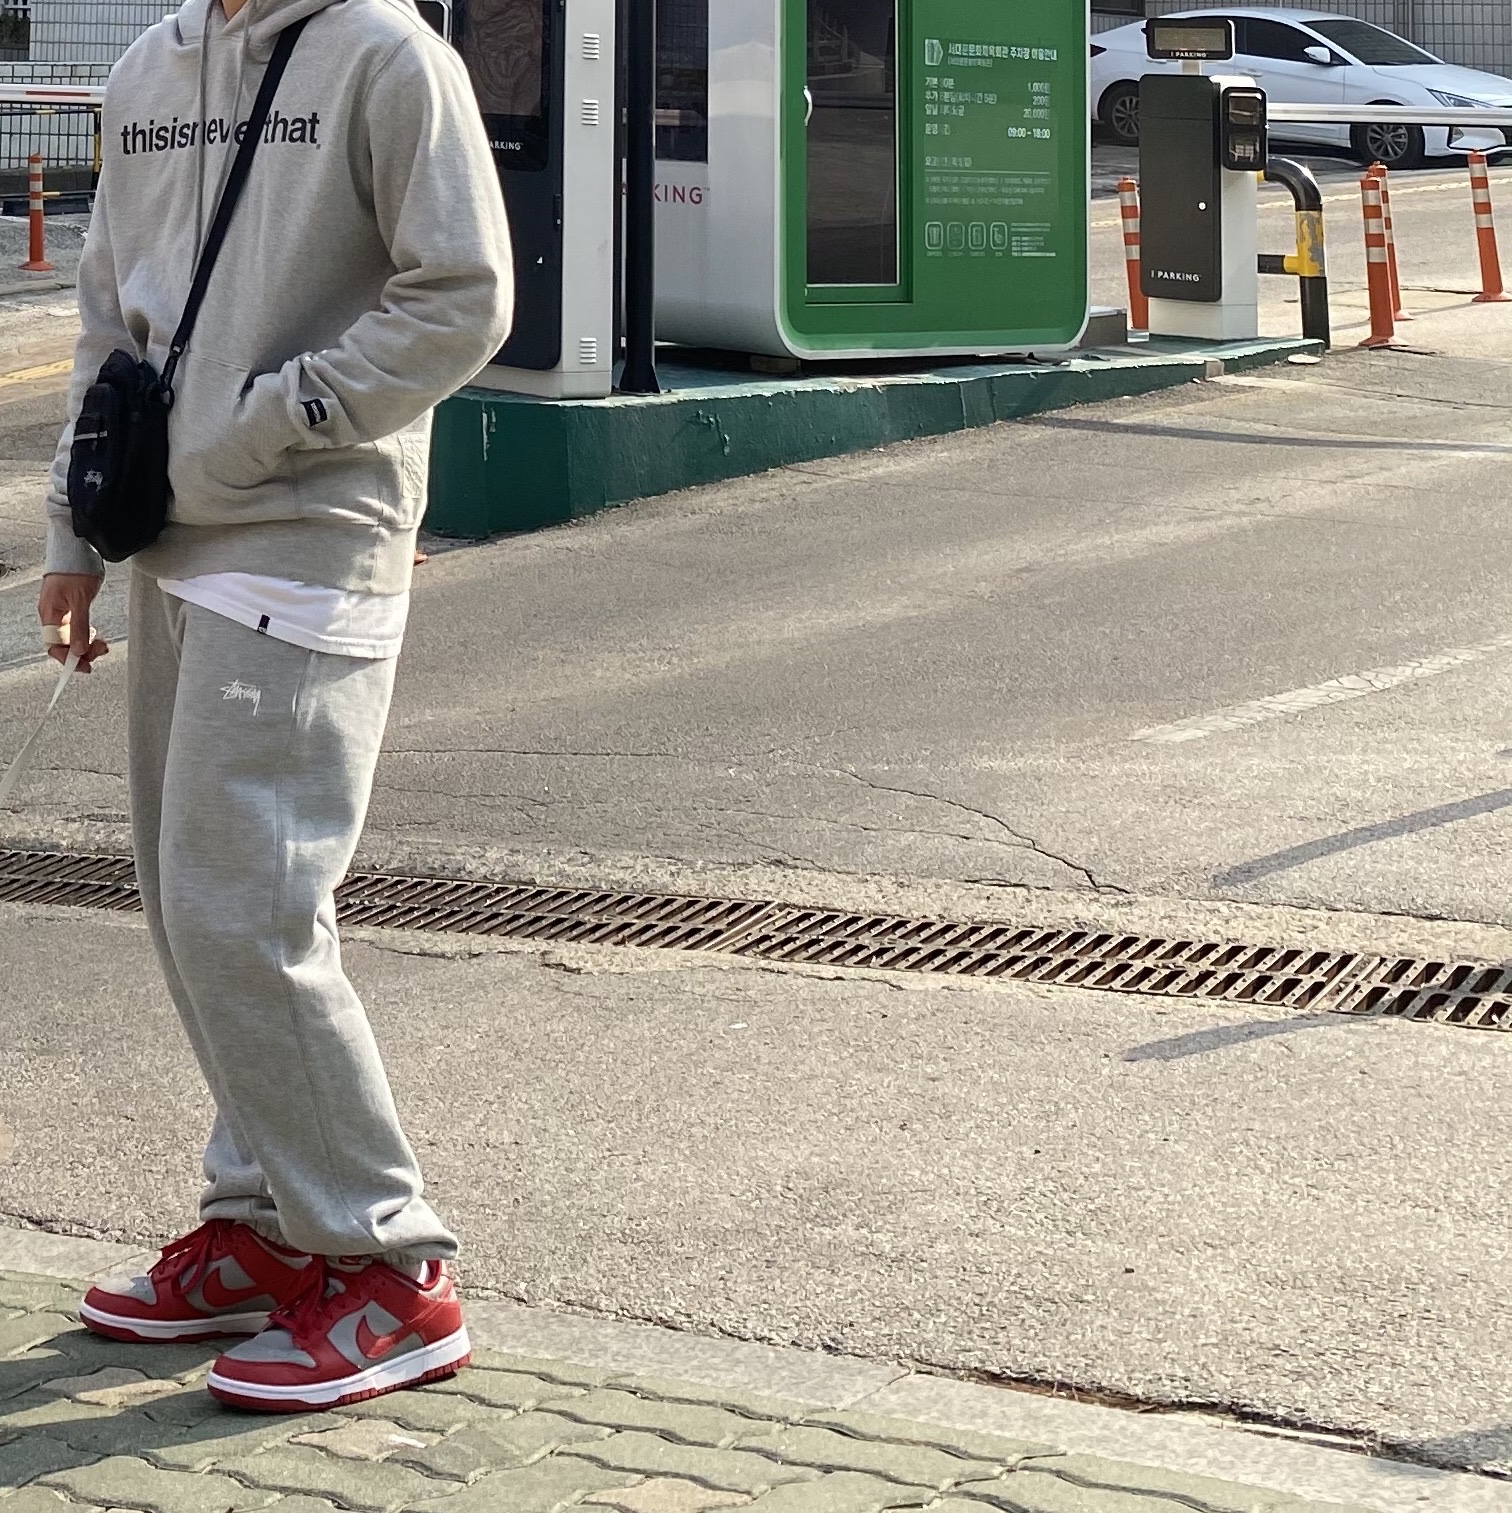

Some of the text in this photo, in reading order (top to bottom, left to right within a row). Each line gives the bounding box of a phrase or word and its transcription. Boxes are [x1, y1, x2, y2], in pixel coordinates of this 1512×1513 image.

[1010, 46, 1030, 60] 주차장
[1008, 127, 1026, 138] 09:00
[1158, 270, 1200, 282] PARKING
